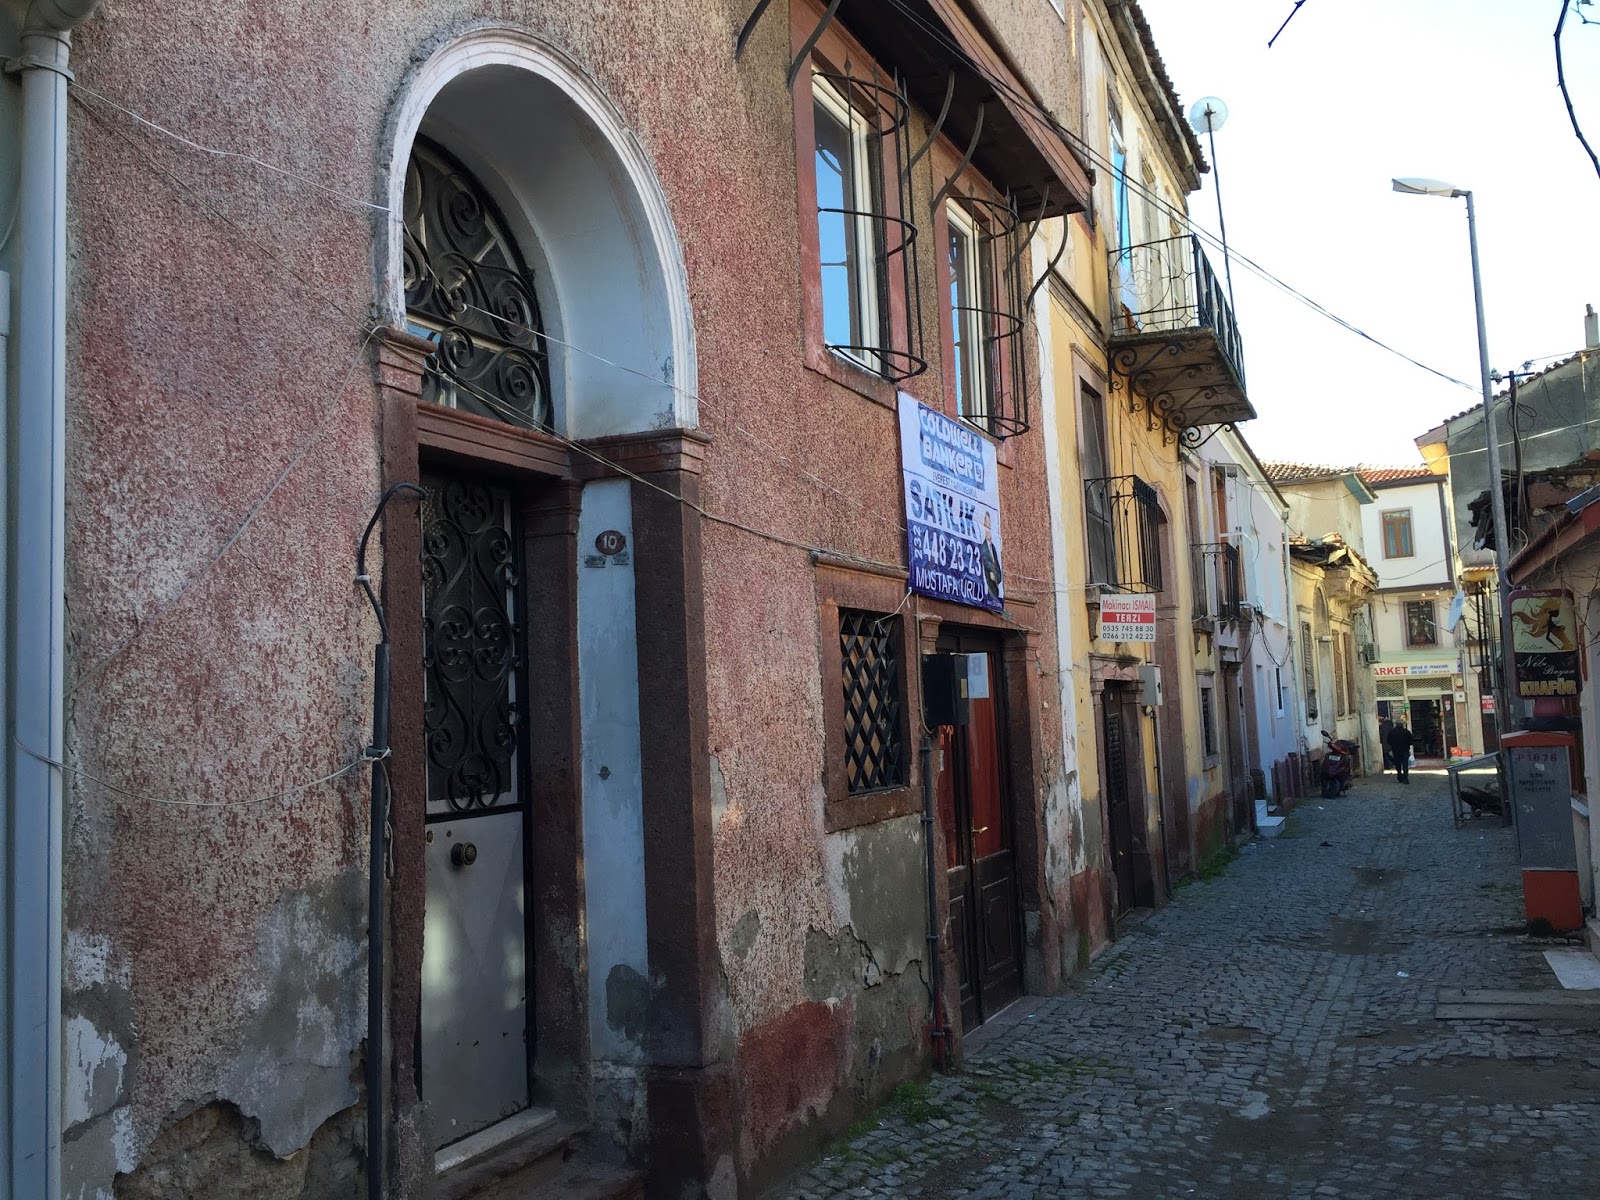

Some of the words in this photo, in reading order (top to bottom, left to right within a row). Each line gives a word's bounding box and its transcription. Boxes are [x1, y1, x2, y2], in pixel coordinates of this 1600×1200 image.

[603, 535, 617, 549] 10
[923, 529, 947, 567] 448
[949, 538, 965, 571] 23
[966, 544, 982, 577] 23
[916, 567, 959, 596] MUSTAFA
[961, 578, 984, 601] URLU
[1520, 677, 1577, 696] KUAFÖR
